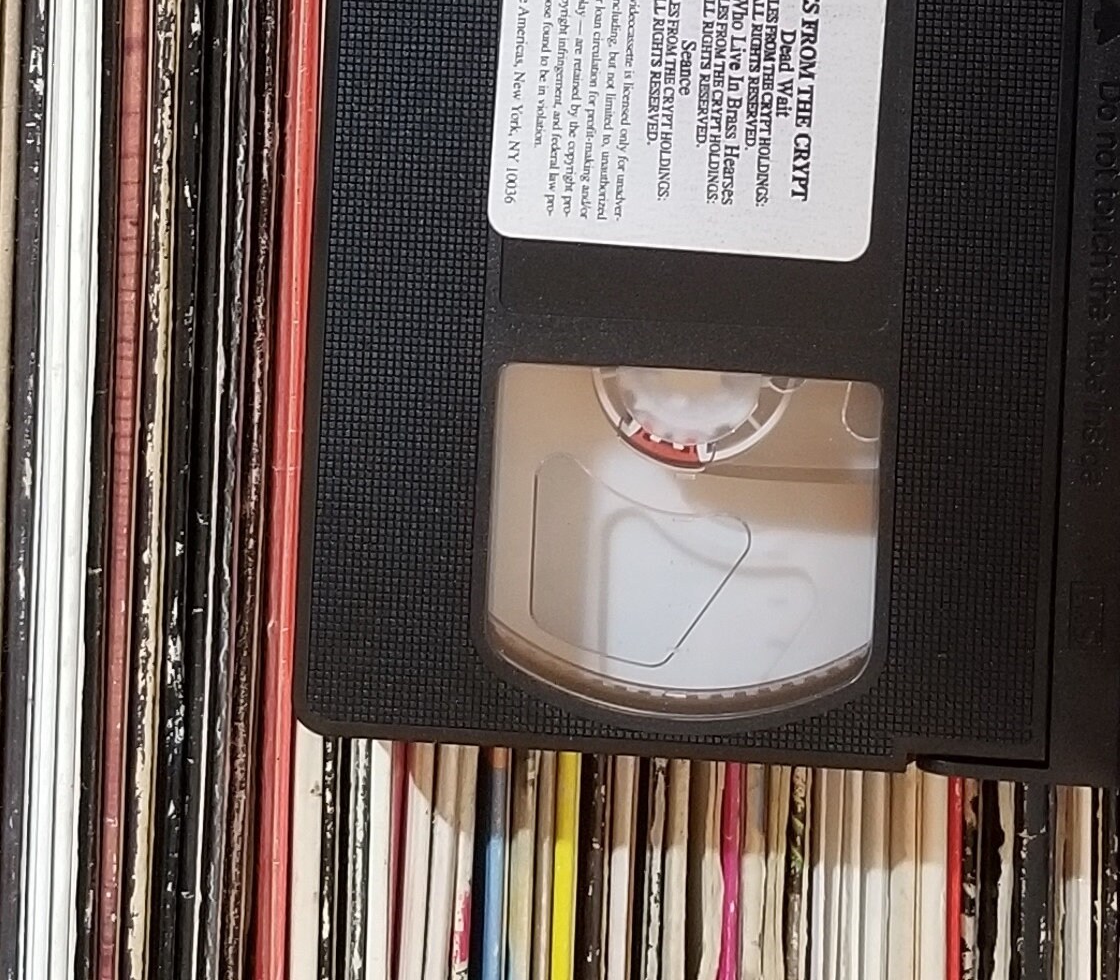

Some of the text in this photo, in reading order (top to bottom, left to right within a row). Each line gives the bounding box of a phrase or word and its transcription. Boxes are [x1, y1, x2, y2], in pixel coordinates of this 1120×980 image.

[512, 5, 531, 68] Americas,
[593, 5, 607, 29] loan
[540, 21, 554, 53] found
[574, 37, 584, 55] are
[650, 16, 666, 68] RIGHTS
[664, 19, 681, 57] FROM
[699, 19, 716, 71] RIGHTS
[713, 21, 729, 60] FROM
[727, 34, 748, 72] Live
[748, 22, 764, 74] RIGHTS
[762, 23, 779, 63] FROM
[797, 17, 820, 81] FROM
[570, 57, 584, 101] retained
[588, 31, 604, 88] circulation
[607, 51, 620, 69] but
[663, 57, 677, 86] THE
[677, 39, 698, 96] Seance
[712, 60, 727, 89] THE
[761, 63, 776, 92] THE
[774, 28, 798, 119] Dead Wait
[512, 71, 526, 101] New
[587, 90, 600, 107] for
[605, 72, 616, 90] not
[726, 74, 746, 96] In
[507, 104, 524, 137] York,
[552, 110, 563, 131] and
[603, 93, 617, 131] limited
[620, 82, 635, 126] licensed
[646, 69, 663, 146] RESERVED.
[660, 86, 676, 130] CRYPT
[695, 72, 712, 148] RESERVED.
[709, 88, 725, 134] CRYPT
[724, 95, 744, 140] Brass
[744, 74, 761, 151] RESERVED.
[758, 91, 774, 137] CRYPT
[794, 84, 815, 129] THE
[568, 121, 581, 139] the
[600, 134, 612, 148] to,
[615, 128, 630, 153] only
[507, 140, 521, 163] NY
[548, 133, 563, 170] federal
[562, 140, 577, 193] copyright
[617, 155, 629, 172] for
[657, 130, 673, 201] HOLDINGS:
[706, 133, 722, 204] HOLDINGS:
[790, 132, 813, 203] CRYPT
[503, 167, 519, 204] 10036
[548, 172, 560, 192] law
[596, 151, 611, 221] unauthorized
[720, 143, 741, 206] Hearses
[755, 136, 772, 208] HOLDINGS:
[579, 184, 592, 220] and/or
